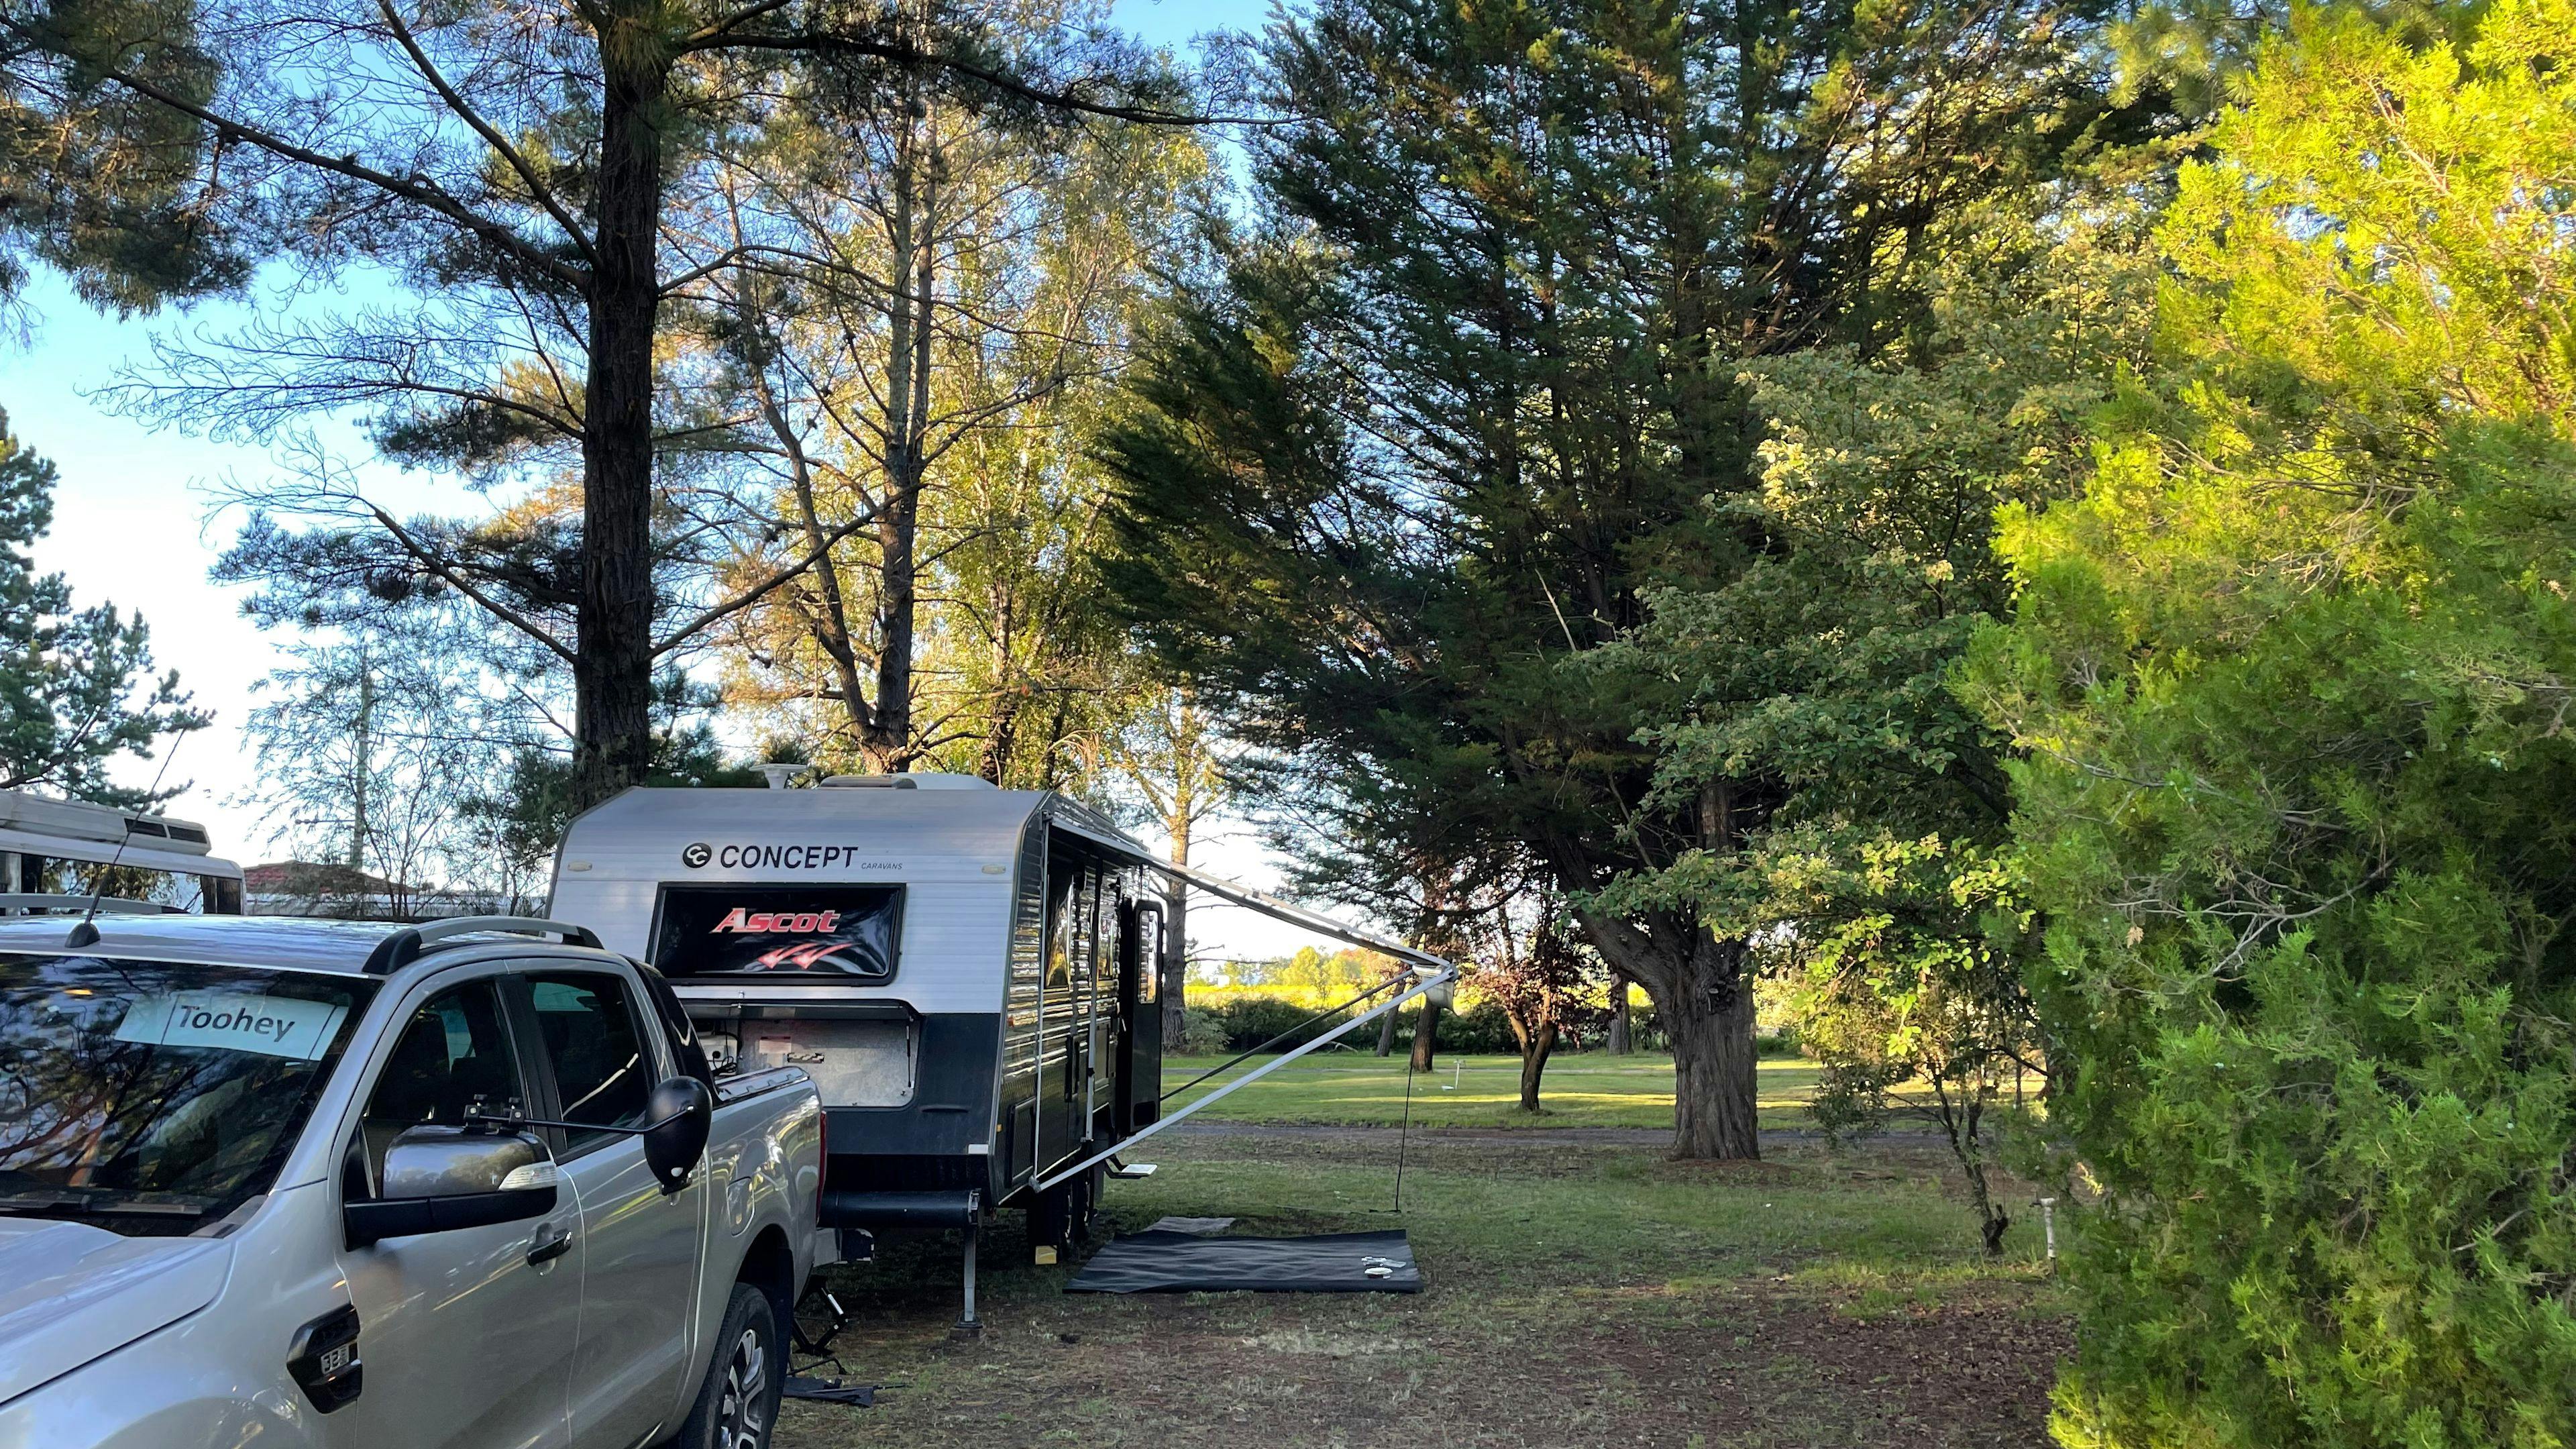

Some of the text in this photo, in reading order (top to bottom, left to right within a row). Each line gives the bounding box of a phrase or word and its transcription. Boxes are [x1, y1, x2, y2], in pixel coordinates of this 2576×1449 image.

[720, 845, 859, 868] CONCEPT
[708, 908, 841, 934] Ascot
[180, 1005, 295, 1042] Toohey
